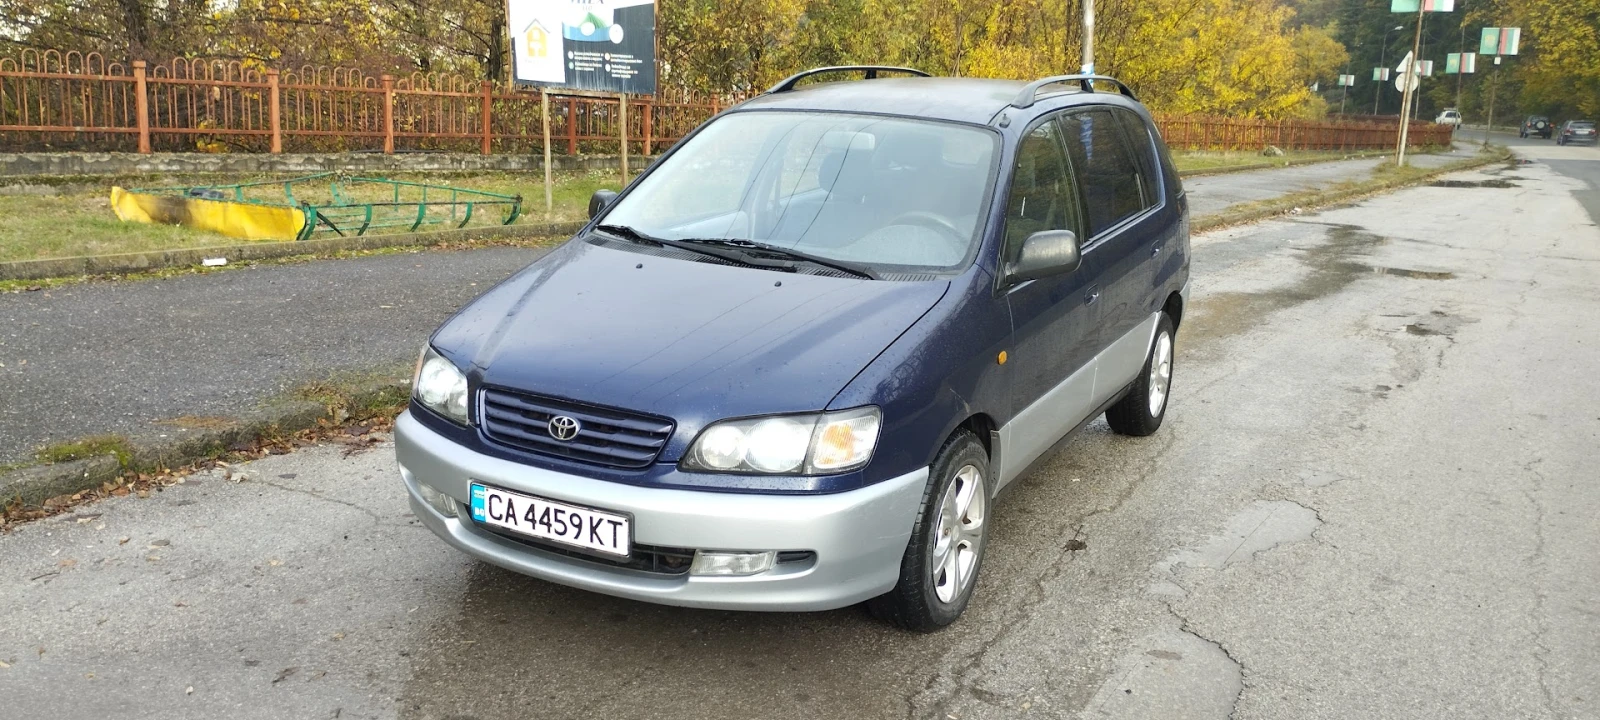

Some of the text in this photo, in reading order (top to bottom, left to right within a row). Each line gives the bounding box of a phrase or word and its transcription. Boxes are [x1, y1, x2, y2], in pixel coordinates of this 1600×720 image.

[488, 494, 623, 548] CA 4459 KT
